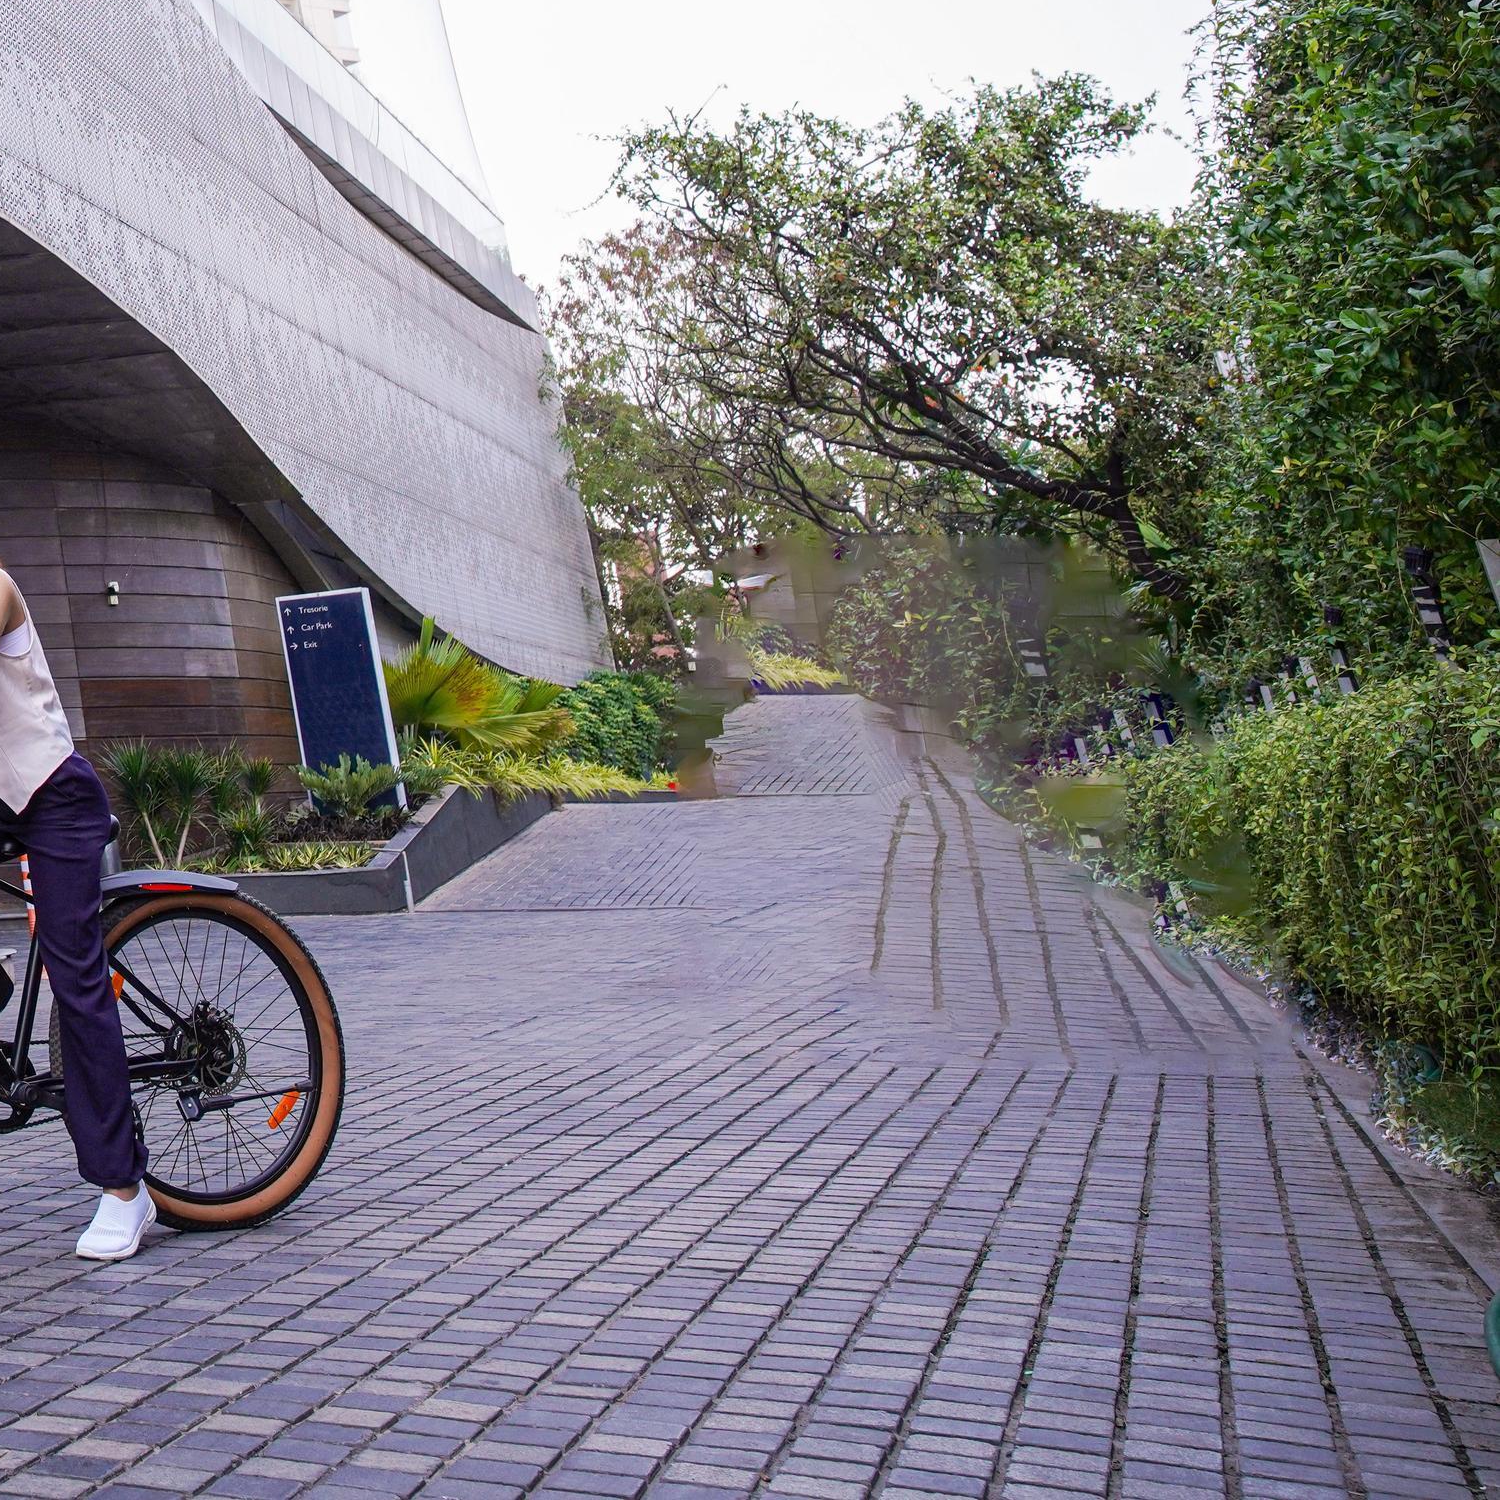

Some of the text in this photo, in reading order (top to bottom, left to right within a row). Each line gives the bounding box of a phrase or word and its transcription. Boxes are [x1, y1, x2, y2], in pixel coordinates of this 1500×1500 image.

[301, 621, 333, 632] Car Park
[303, 641, 318, 649] Exit
